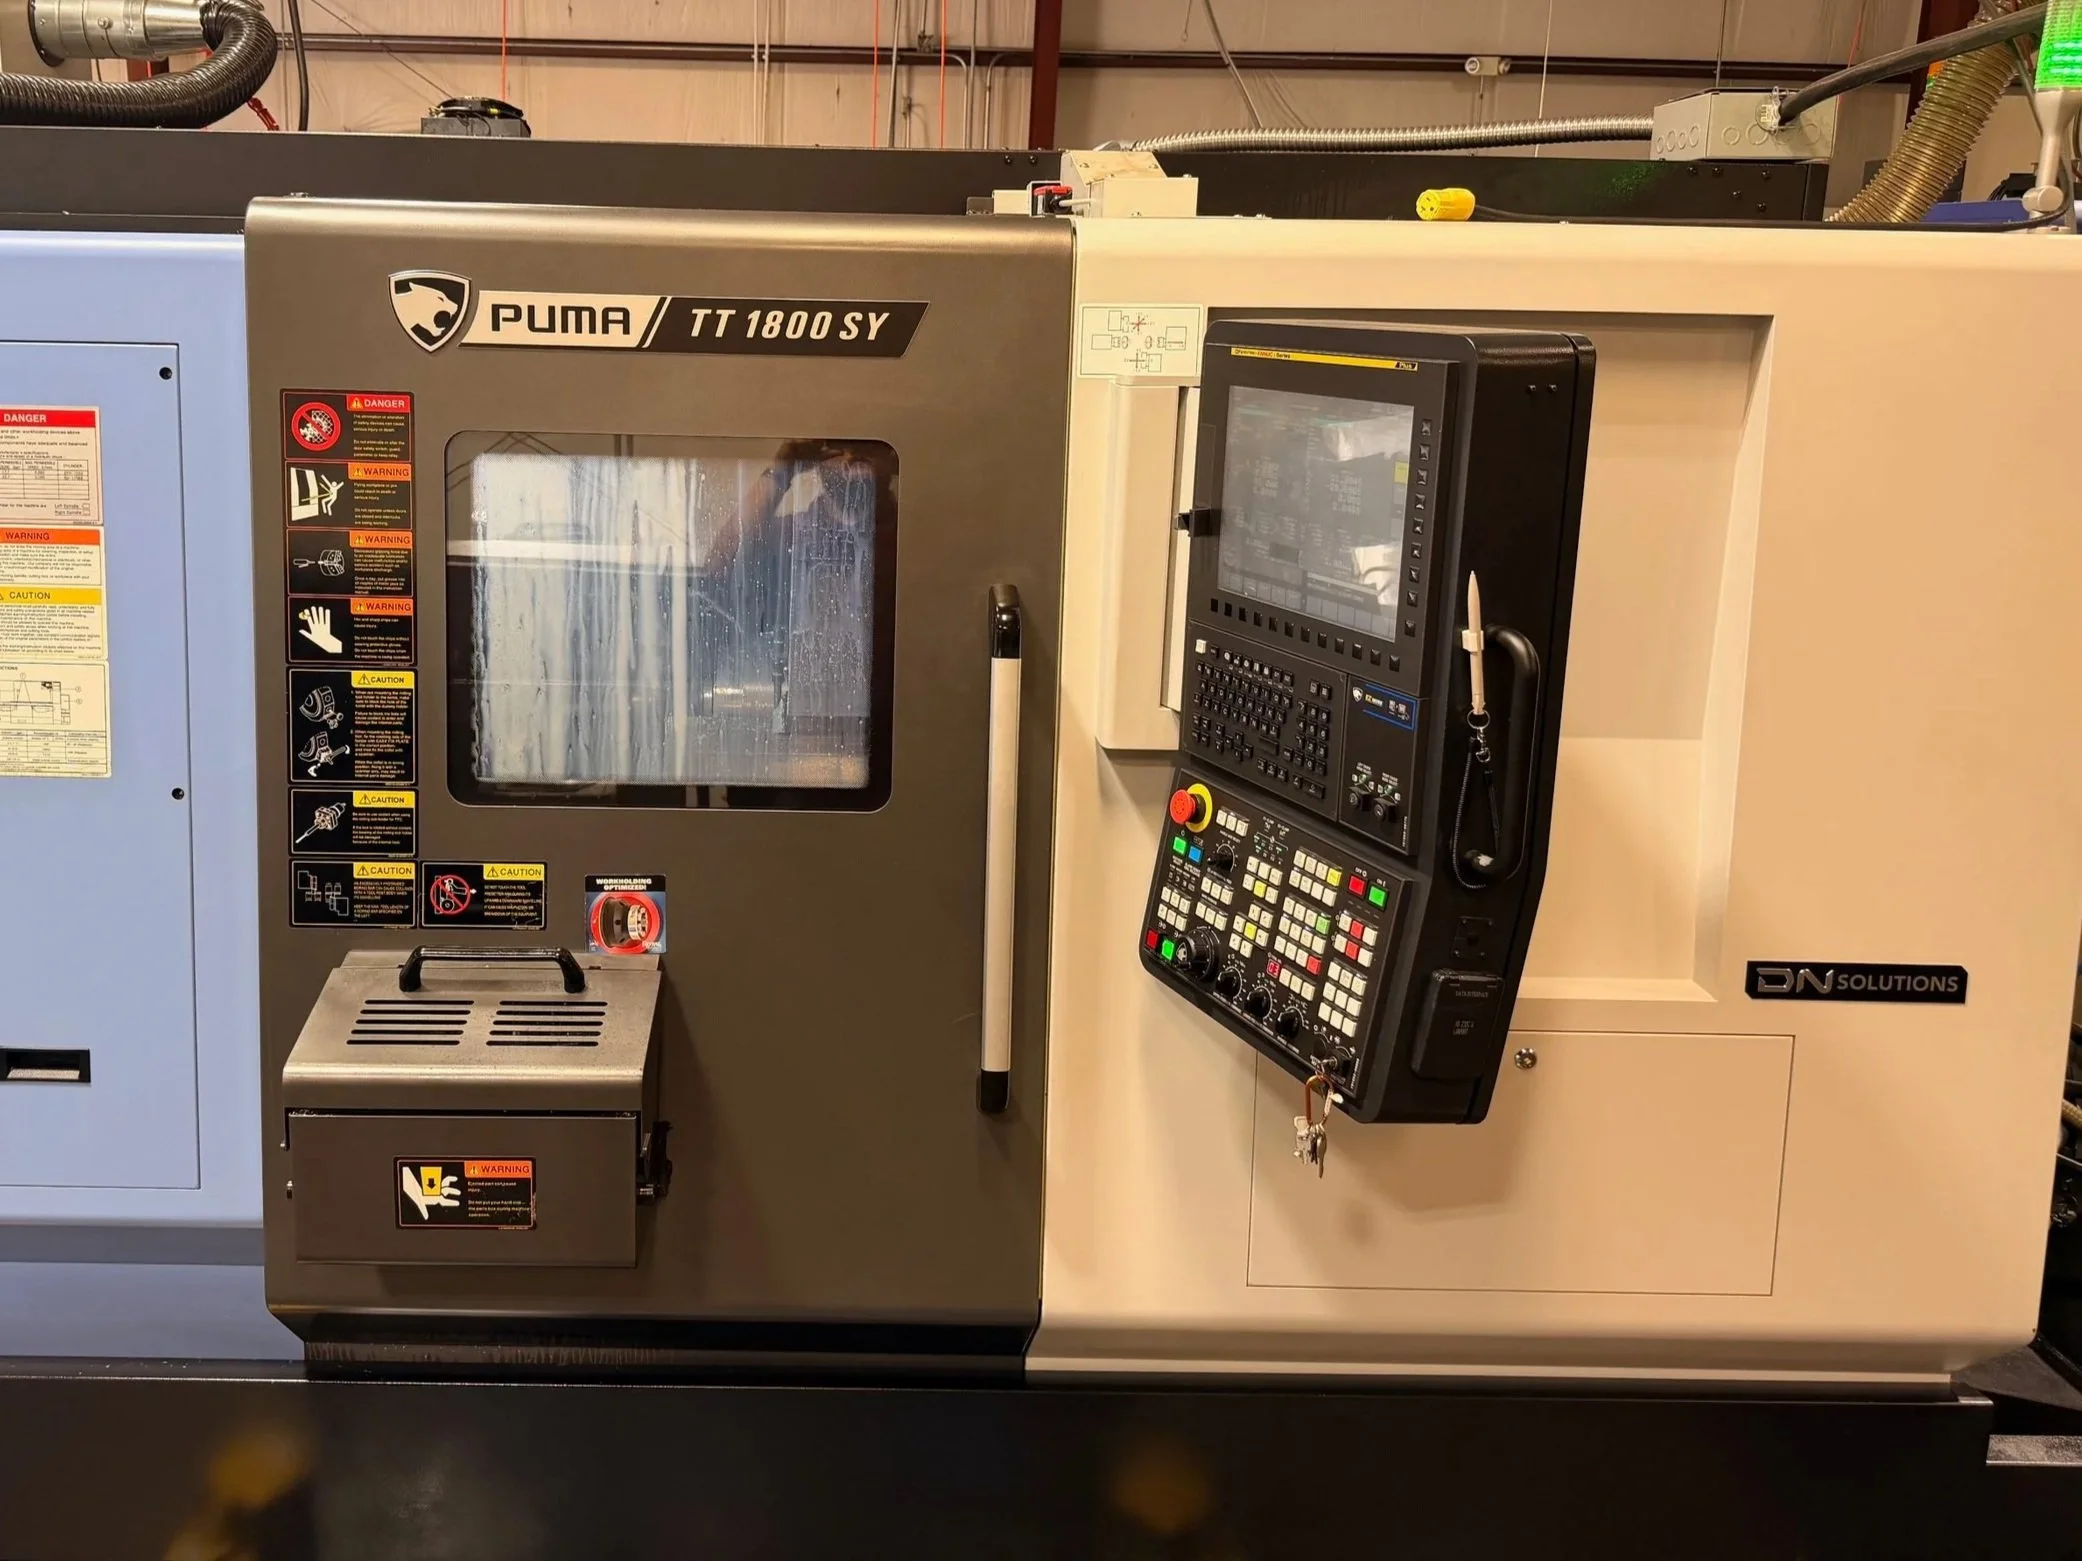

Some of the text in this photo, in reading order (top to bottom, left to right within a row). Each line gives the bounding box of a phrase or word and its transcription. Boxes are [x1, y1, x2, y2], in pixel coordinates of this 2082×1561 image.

[490, 304, 630, 336] PUMA
[690, 308, 892, 342] TT 1800 SY
[364, 399, 405, 408] DANGER
[4, 414, 46, 423] DANGER
[364, 468, 409, 476] WARNING
[6, 532, 50, 540] WARNING
[365, 536, 410, 544] WARNING
[10, 592, 50, 600] CAUTION
[366, 603, 411, 611] WARNING
[370, 866, 412, 874] CAUTION
[1836, 974, 1959, 993] SOLUTIONS
